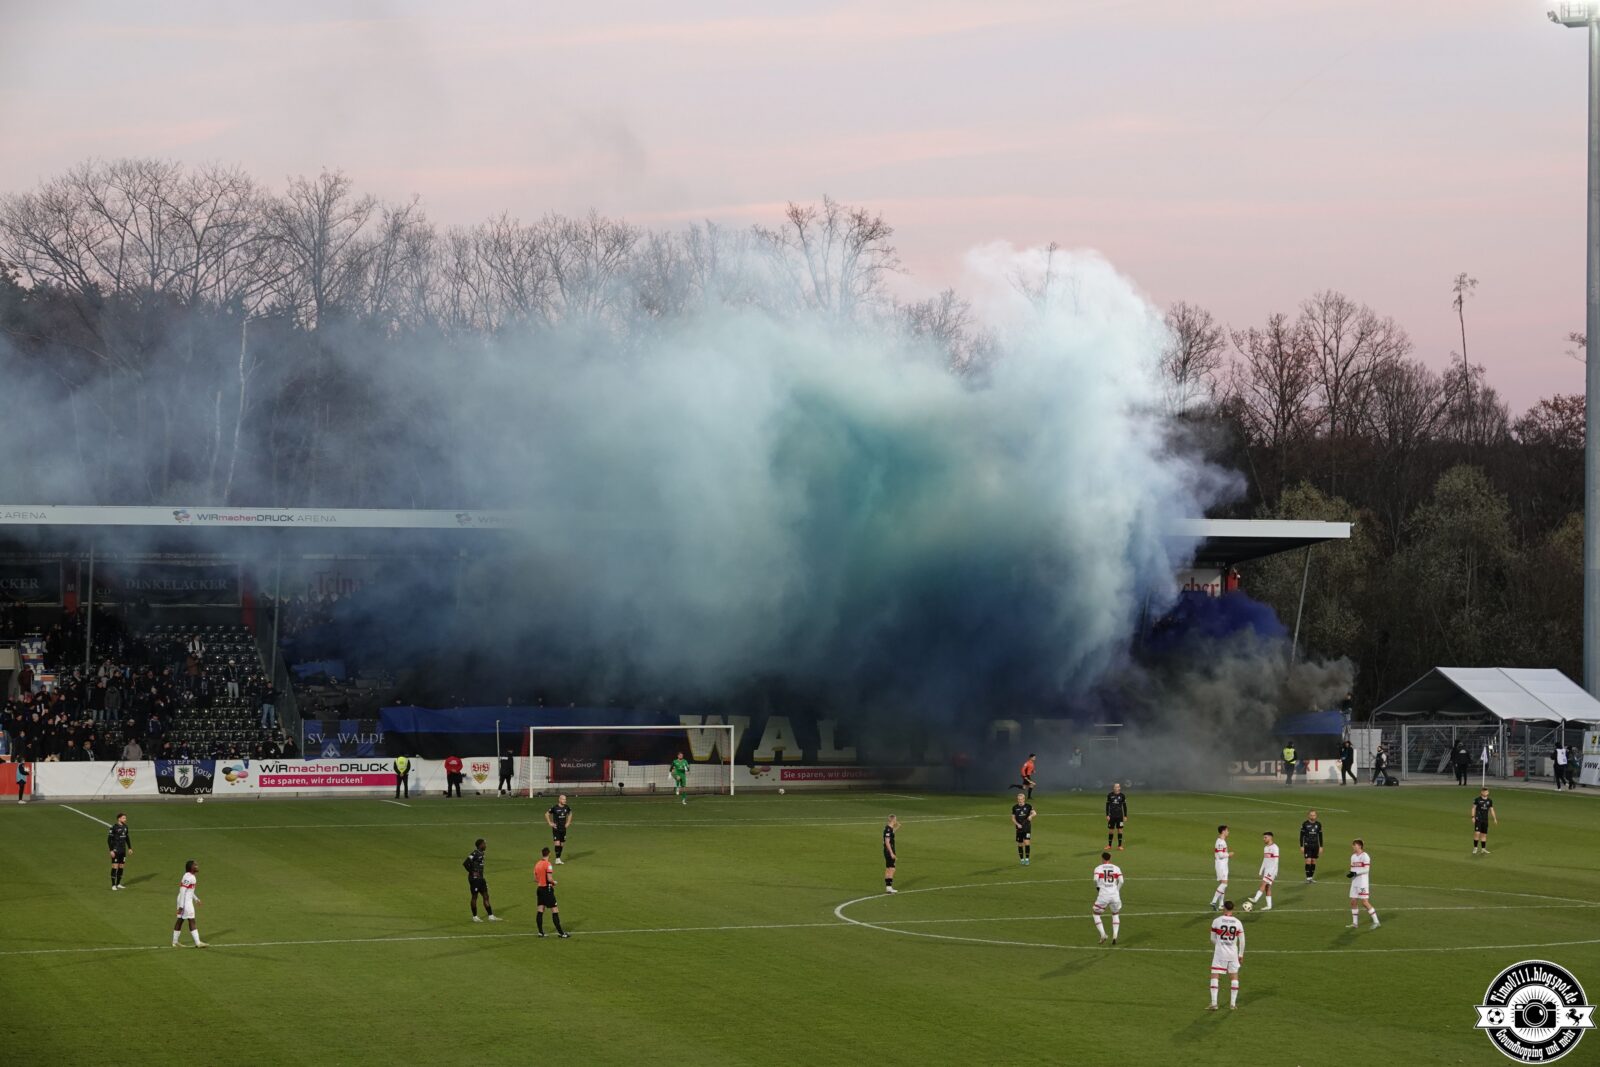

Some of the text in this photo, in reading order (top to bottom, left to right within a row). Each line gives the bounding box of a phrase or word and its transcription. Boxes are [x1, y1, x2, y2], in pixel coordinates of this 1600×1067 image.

[197, 514, 294, 522] WIRmachenDRUCK
[126, 578, 228, 590] DINKELACKER
[308, 733, 326, 744] SV
[277, 778, 308, 787] sparen,
[326, 776, 363, 784] drucken!
[1104, 870, 1114, 883] 15
[1220, 926, 1236, 940] 29
